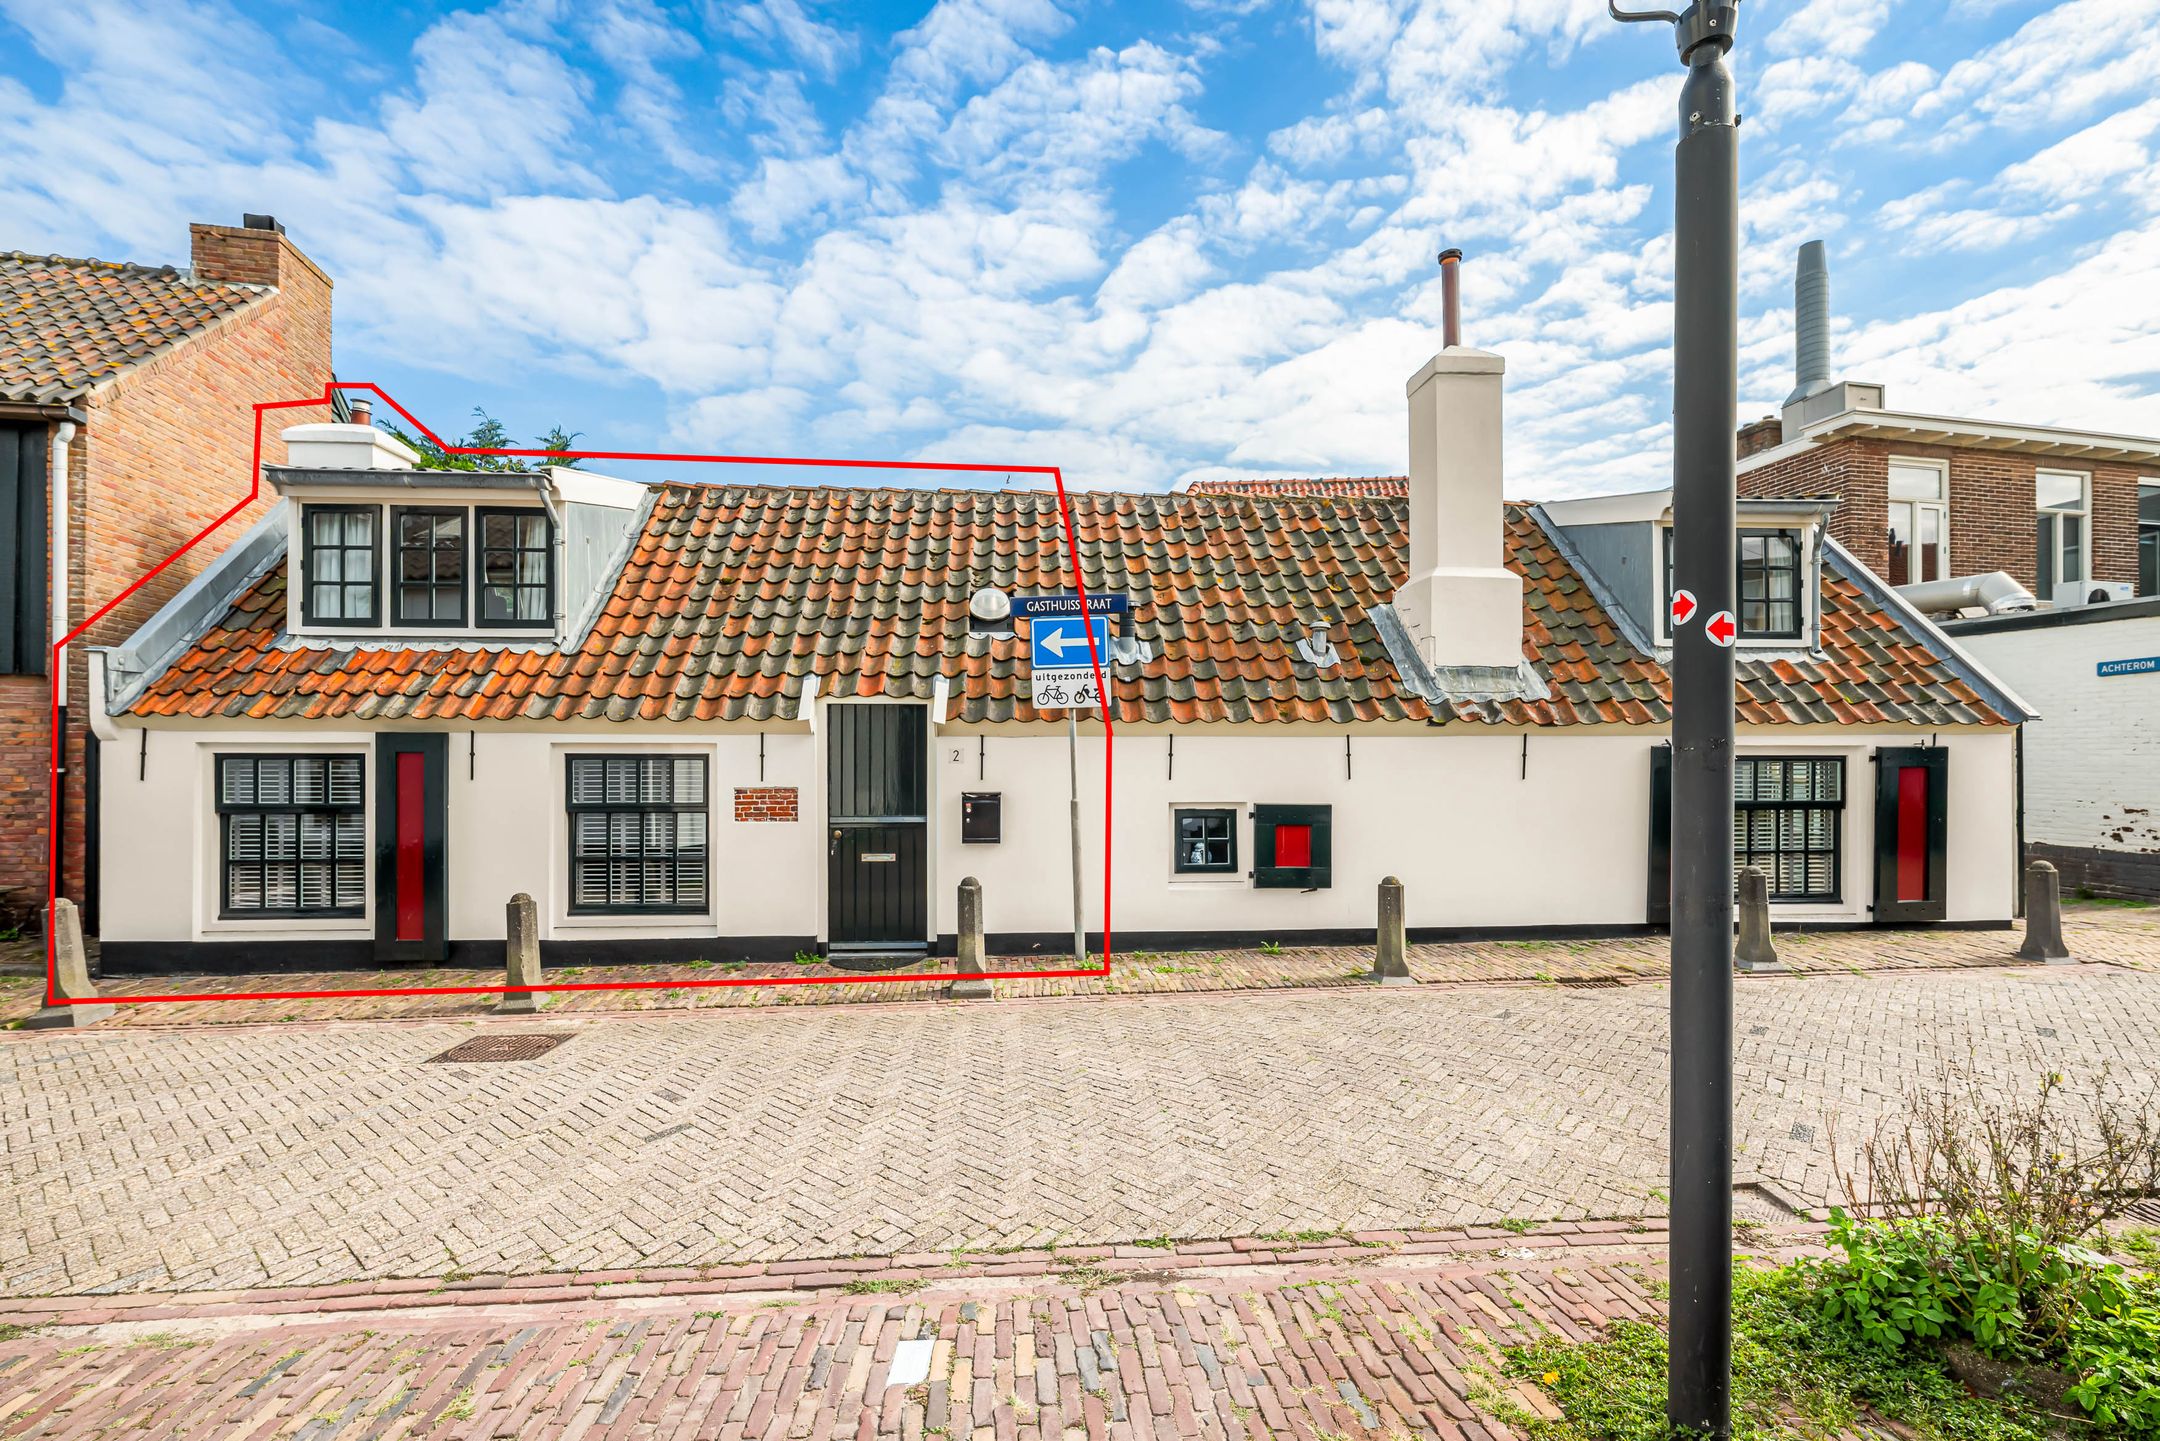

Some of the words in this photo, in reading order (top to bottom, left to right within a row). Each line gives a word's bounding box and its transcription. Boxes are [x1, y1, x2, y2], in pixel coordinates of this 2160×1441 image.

[1026, 598, 1112, 612] GASTHUISSRAAT
[2101, 660, 2155, 673] ACHTEROM
[1035, 671, 1107, 683] uitgezonded
[953, 749, 960, 762] 2
